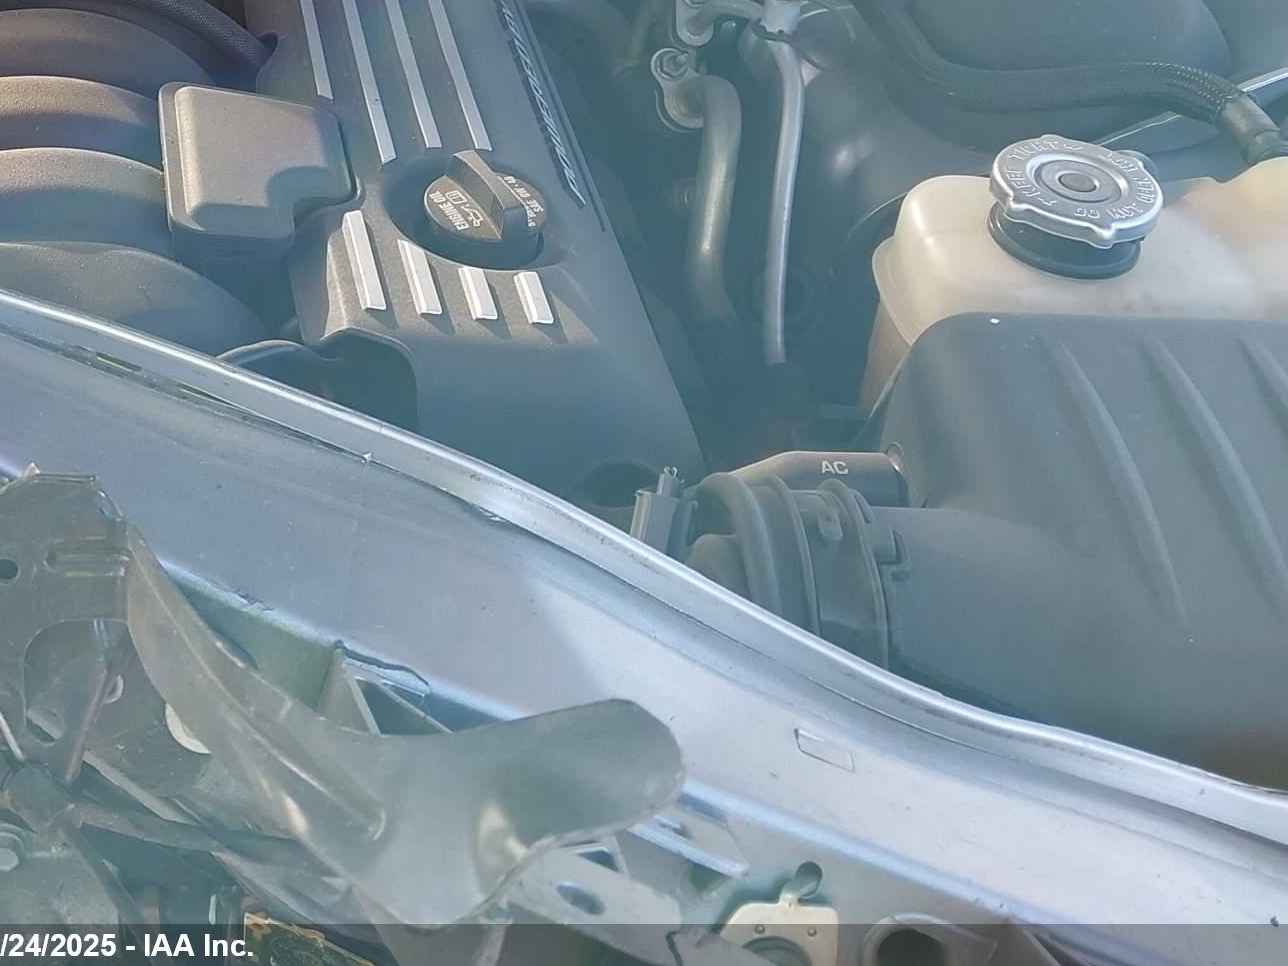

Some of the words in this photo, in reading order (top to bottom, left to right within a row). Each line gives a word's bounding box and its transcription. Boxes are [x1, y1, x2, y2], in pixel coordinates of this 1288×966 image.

[428, 190, 447, 203] OIL
[439, 201, 470, 231] ENGINE
[1073, 206, 1101, 219] DO
[1107, 201, 1144, 220] NOT
[821, 459, 849, 475] AC
